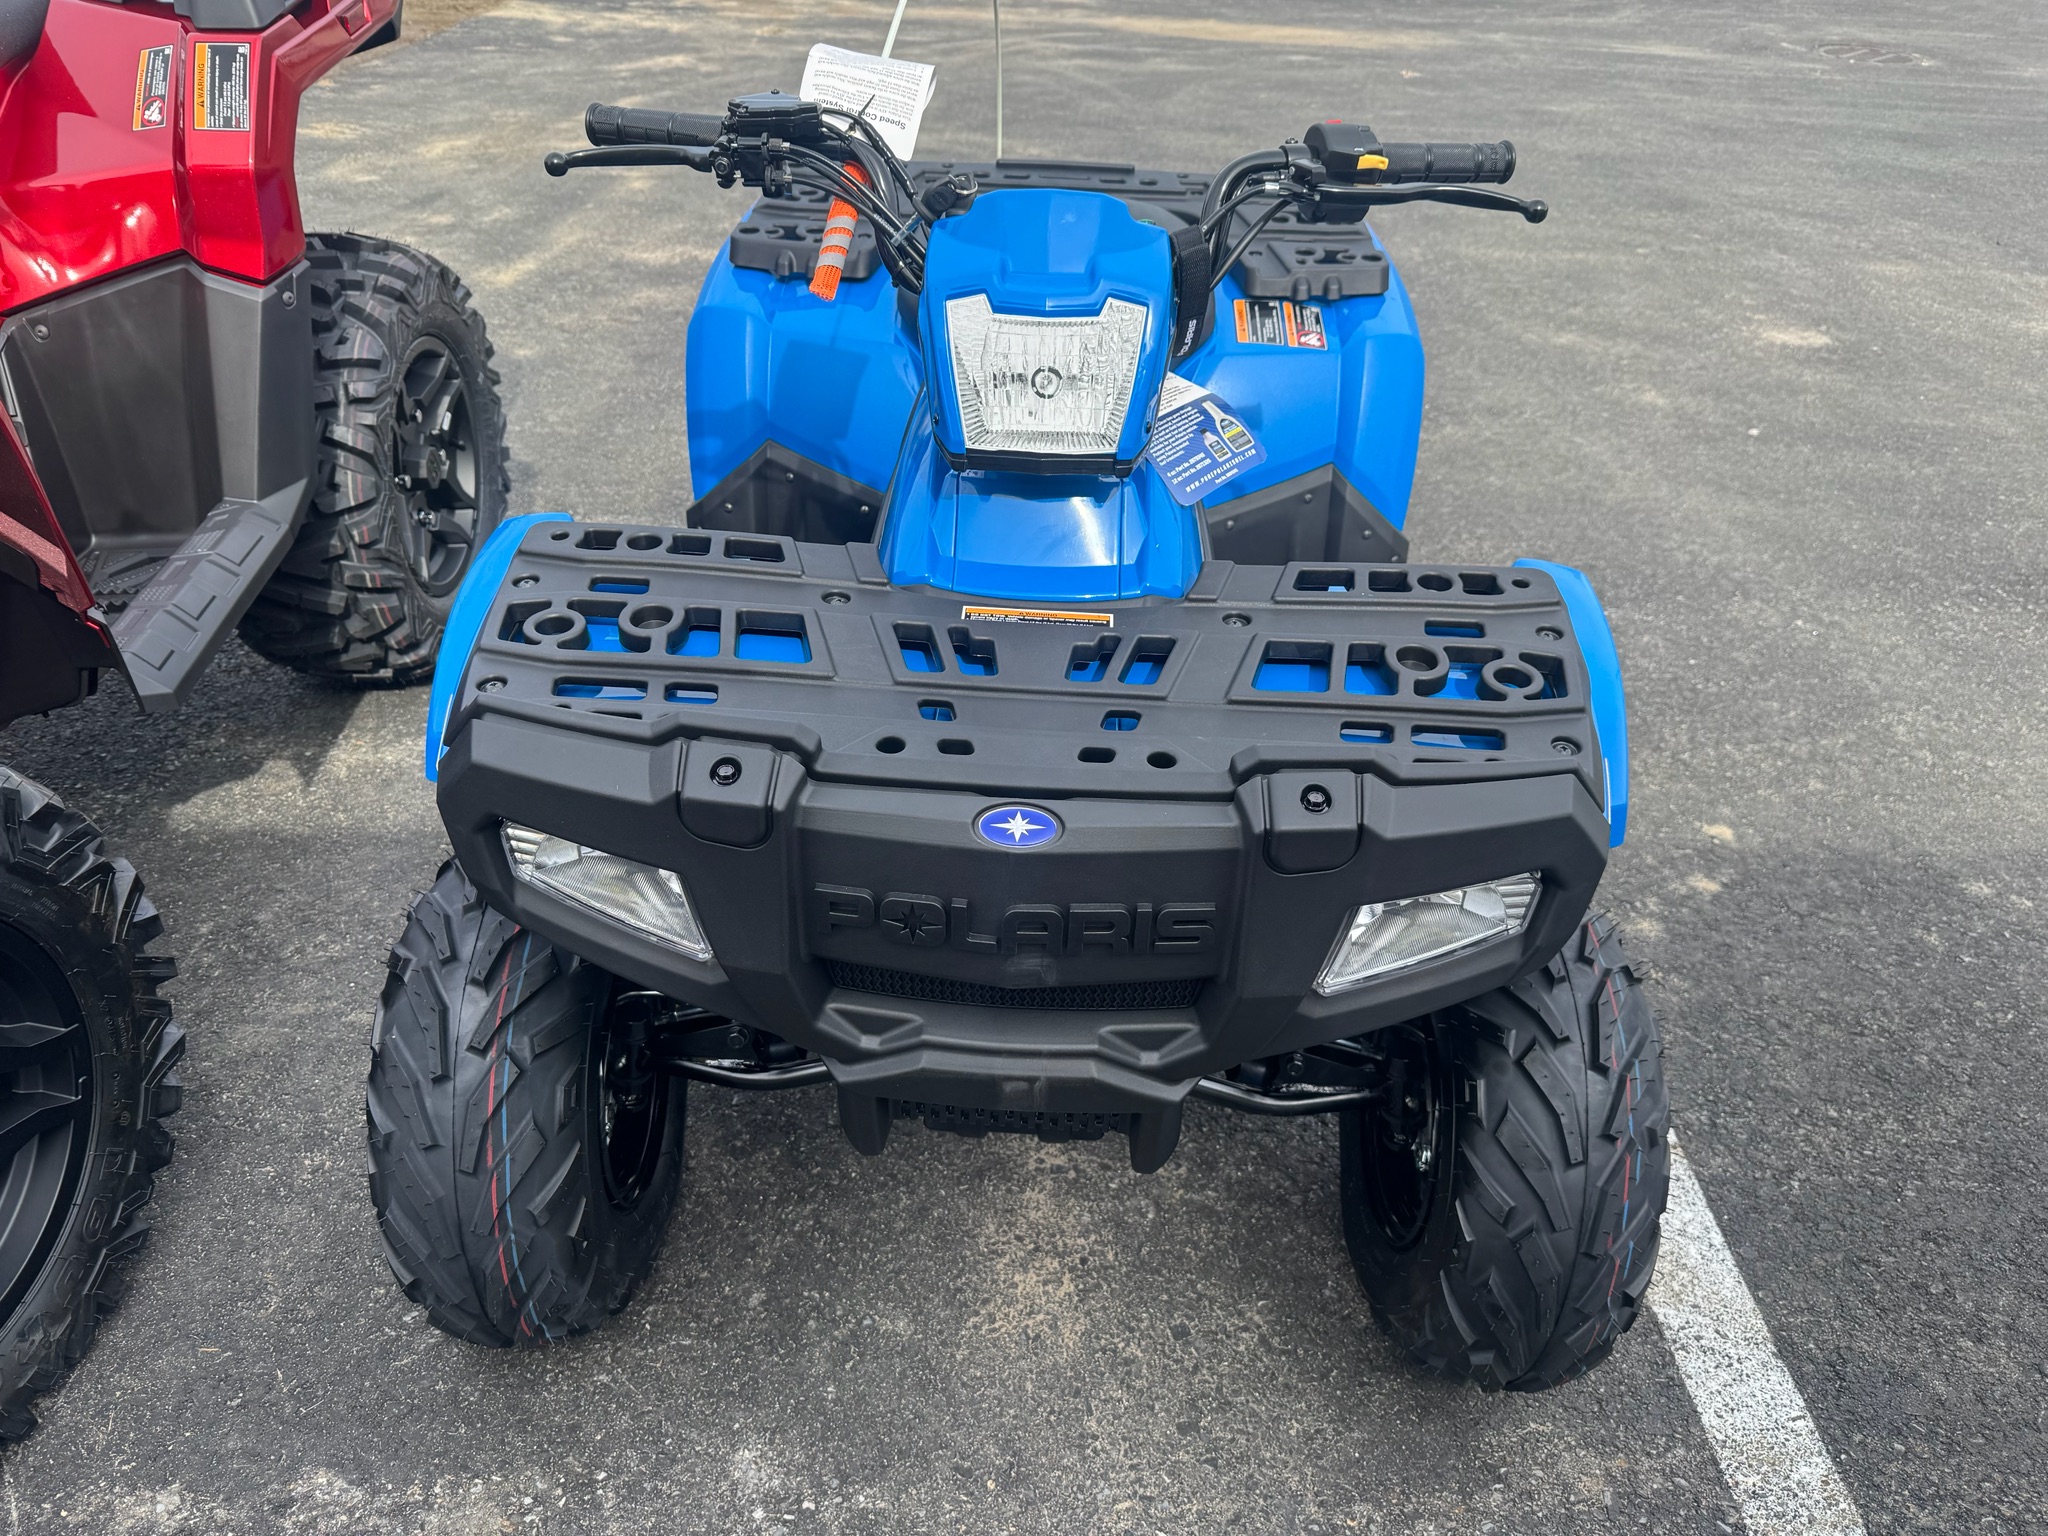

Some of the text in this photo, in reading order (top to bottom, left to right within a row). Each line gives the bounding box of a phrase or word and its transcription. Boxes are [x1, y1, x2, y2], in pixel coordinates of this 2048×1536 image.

[136, 69, 145, 104] WARNING
[197, 63, 205, 99] WARNING
[879, 115, 907, 131] Speed
[814, 881, 1217, 956] POLARIS
